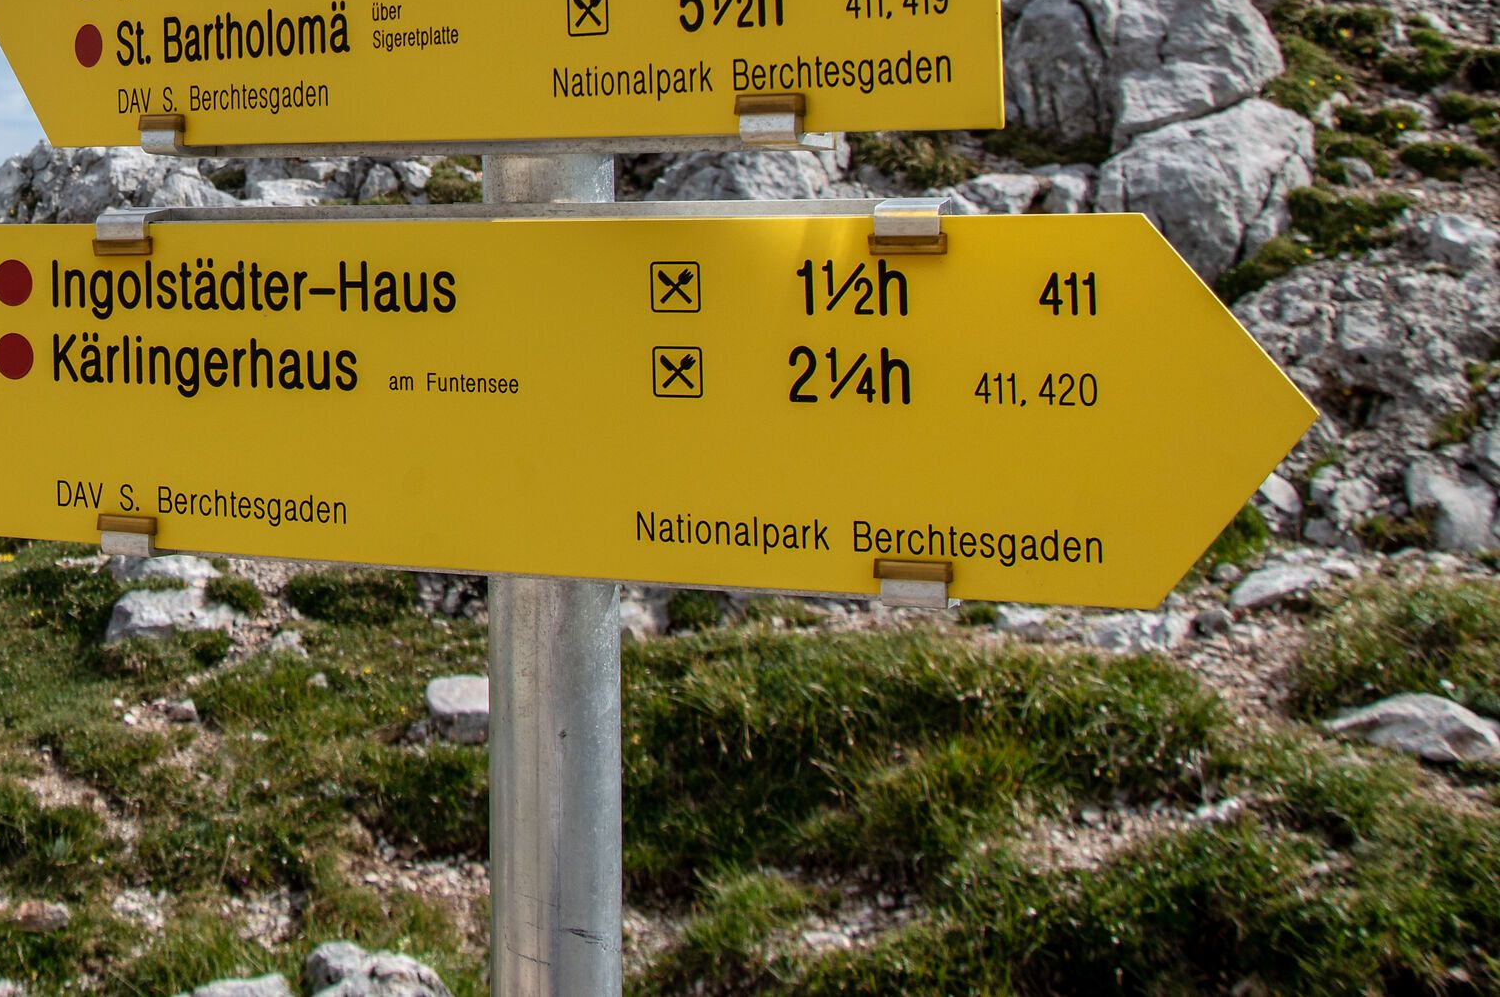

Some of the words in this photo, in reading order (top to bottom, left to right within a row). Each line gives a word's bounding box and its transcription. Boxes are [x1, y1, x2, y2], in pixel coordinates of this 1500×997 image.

[117, 20, 151, 66] St.
[164, 1, 350, 63] Bartholomä
[372, 3, 401, 21] über
[373, 26, 458, 52] Sigeretplatte
[118, 88, 151, 114] DAV
[163, 88, 178, 112] S.
[190, 81, 328, 114] Berchtesgaden
[554, 61, 712, 101] Nationalpark
[733, 50, 951, 93] Berchtesgaden
[1039, 272, 1096, 315] 411
[53, 332, 357, 398] Kärlingerhaus
[389, 376, 413, 390] am
[427, 373, 518, 393] Funtensee
[1039, 373, 1097, 406] 420
[57, 480, 103, 508] DAV
[119, 484, 140, 512] S.
[158, 486, 346, 527] Berchtesgaden
[637, 511, 829, 554] Nationalpark
[854, 521, 1102, 566] Berchtesgaden
